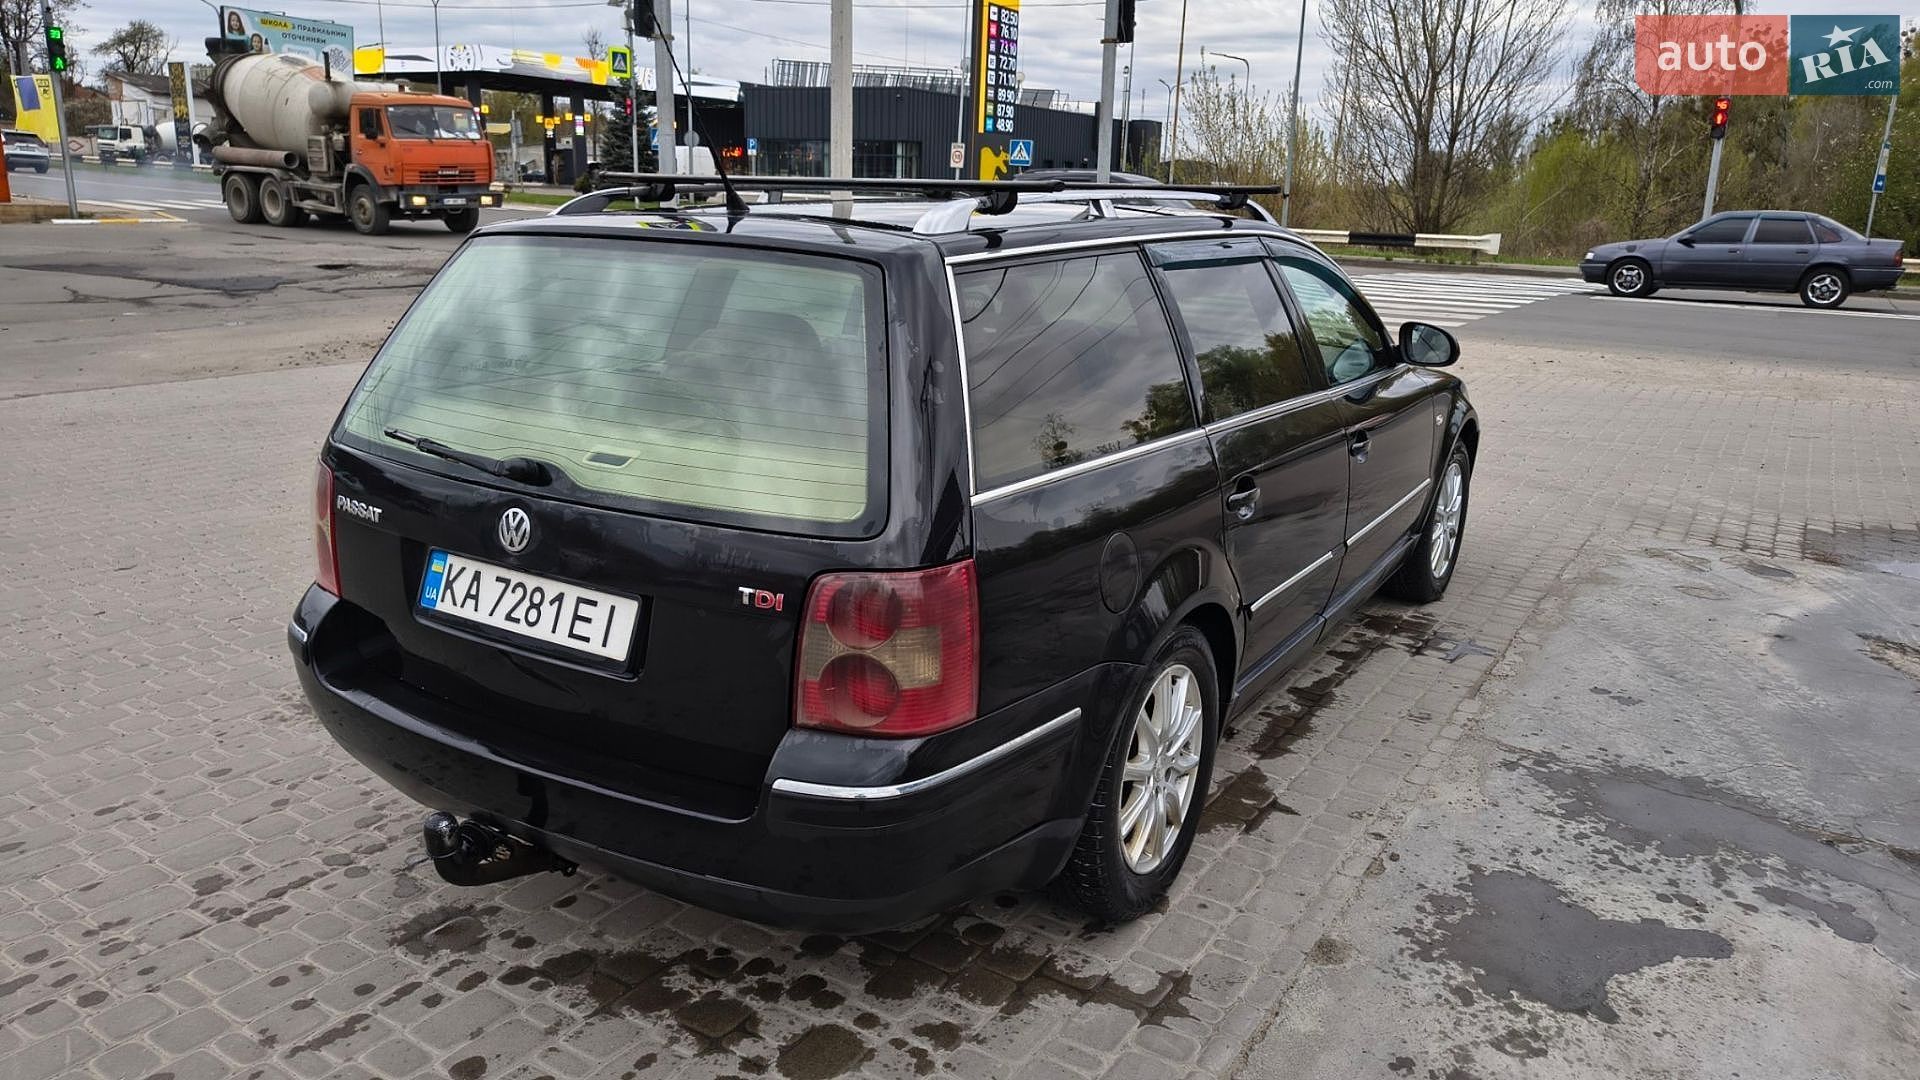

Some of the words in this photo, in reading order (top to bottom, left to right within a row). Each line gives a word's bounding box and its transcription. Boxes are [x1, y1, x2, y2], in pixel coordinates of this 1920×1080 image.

[261, 18, 289, 29] ШКОЛА
[297, 25, 347, 38] ПРАВИЛЬНИМ
[997, 88, 1015, 103] 89.90
[996, 103, 1014, 119] 87.90
[996, 118, 1014, 133] 48.90
[336, 495, 382, 523] PASSAT
[425, 587, 437, 600] UA
[738, 586, 785, 611] TDI
